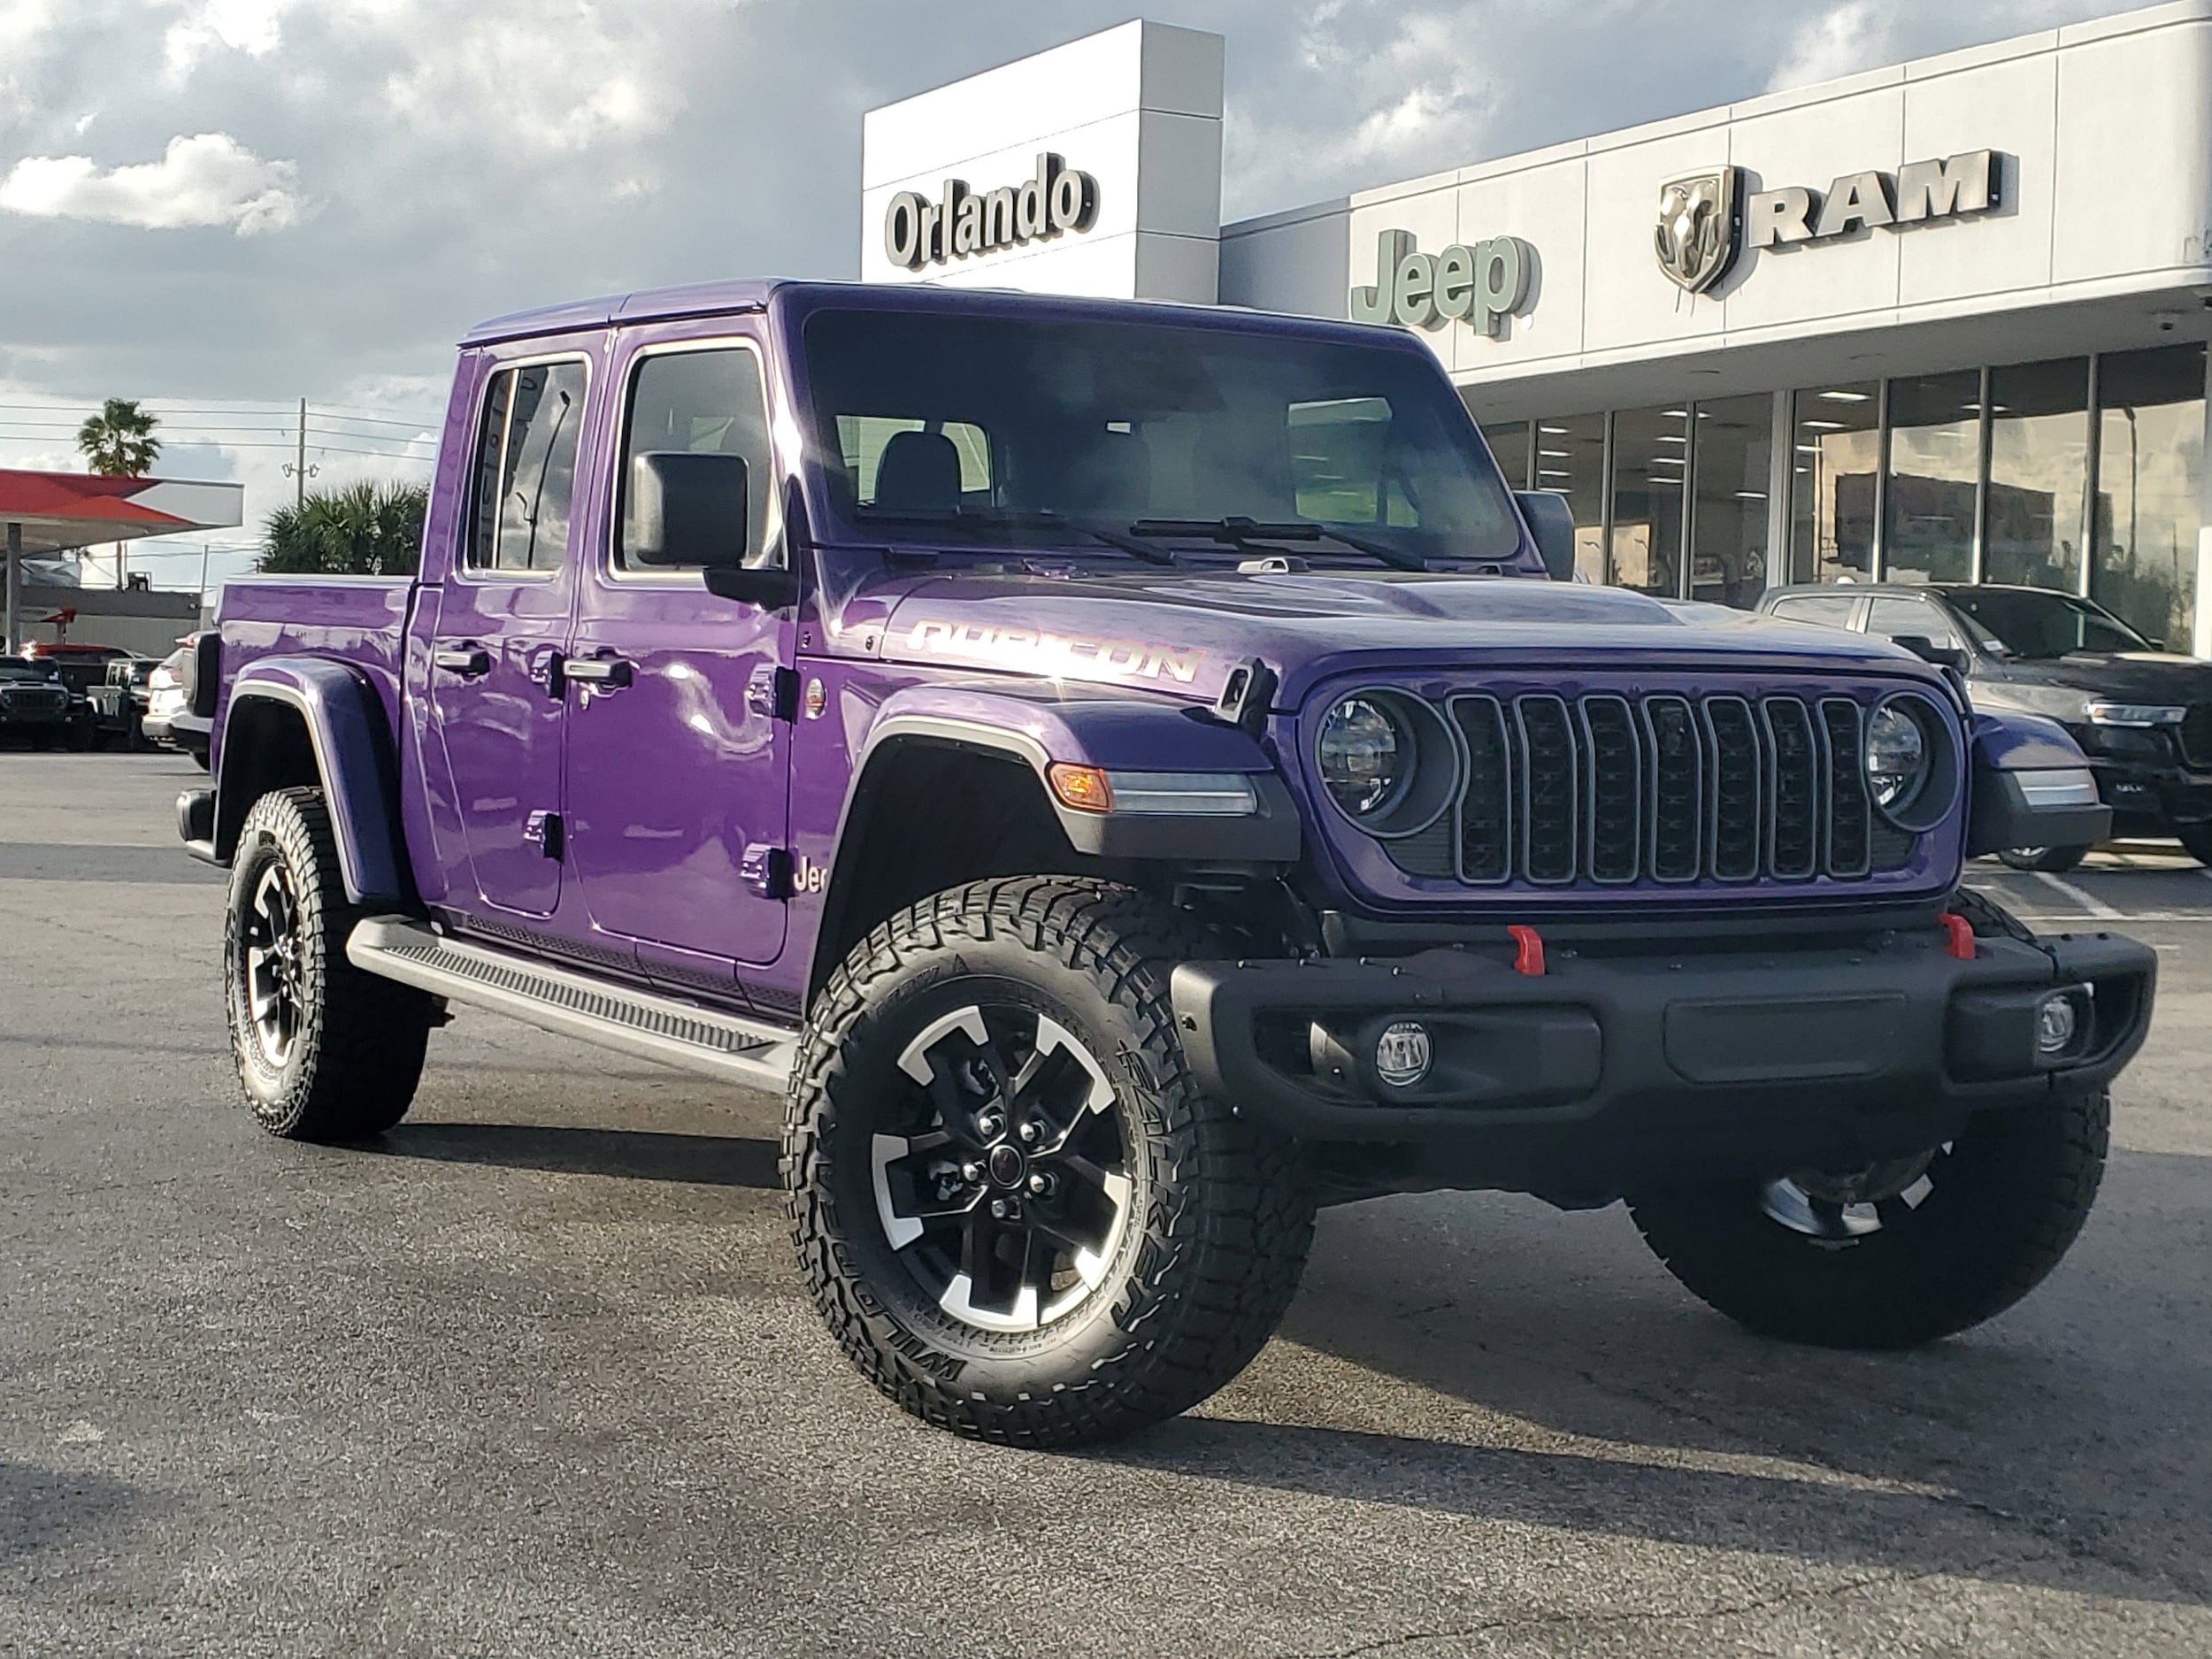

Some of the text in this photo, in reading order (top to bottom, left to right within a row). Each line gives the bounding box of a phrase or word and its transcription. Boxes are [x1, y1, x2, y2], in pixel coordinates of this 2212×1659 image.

[885, 151, 1088, 268] Orlando
[1748, 149, 1996, 249] RAM
[1351, 229, 1524, 336] Jeep
[906, 618, 1206, 682] RUBICON
